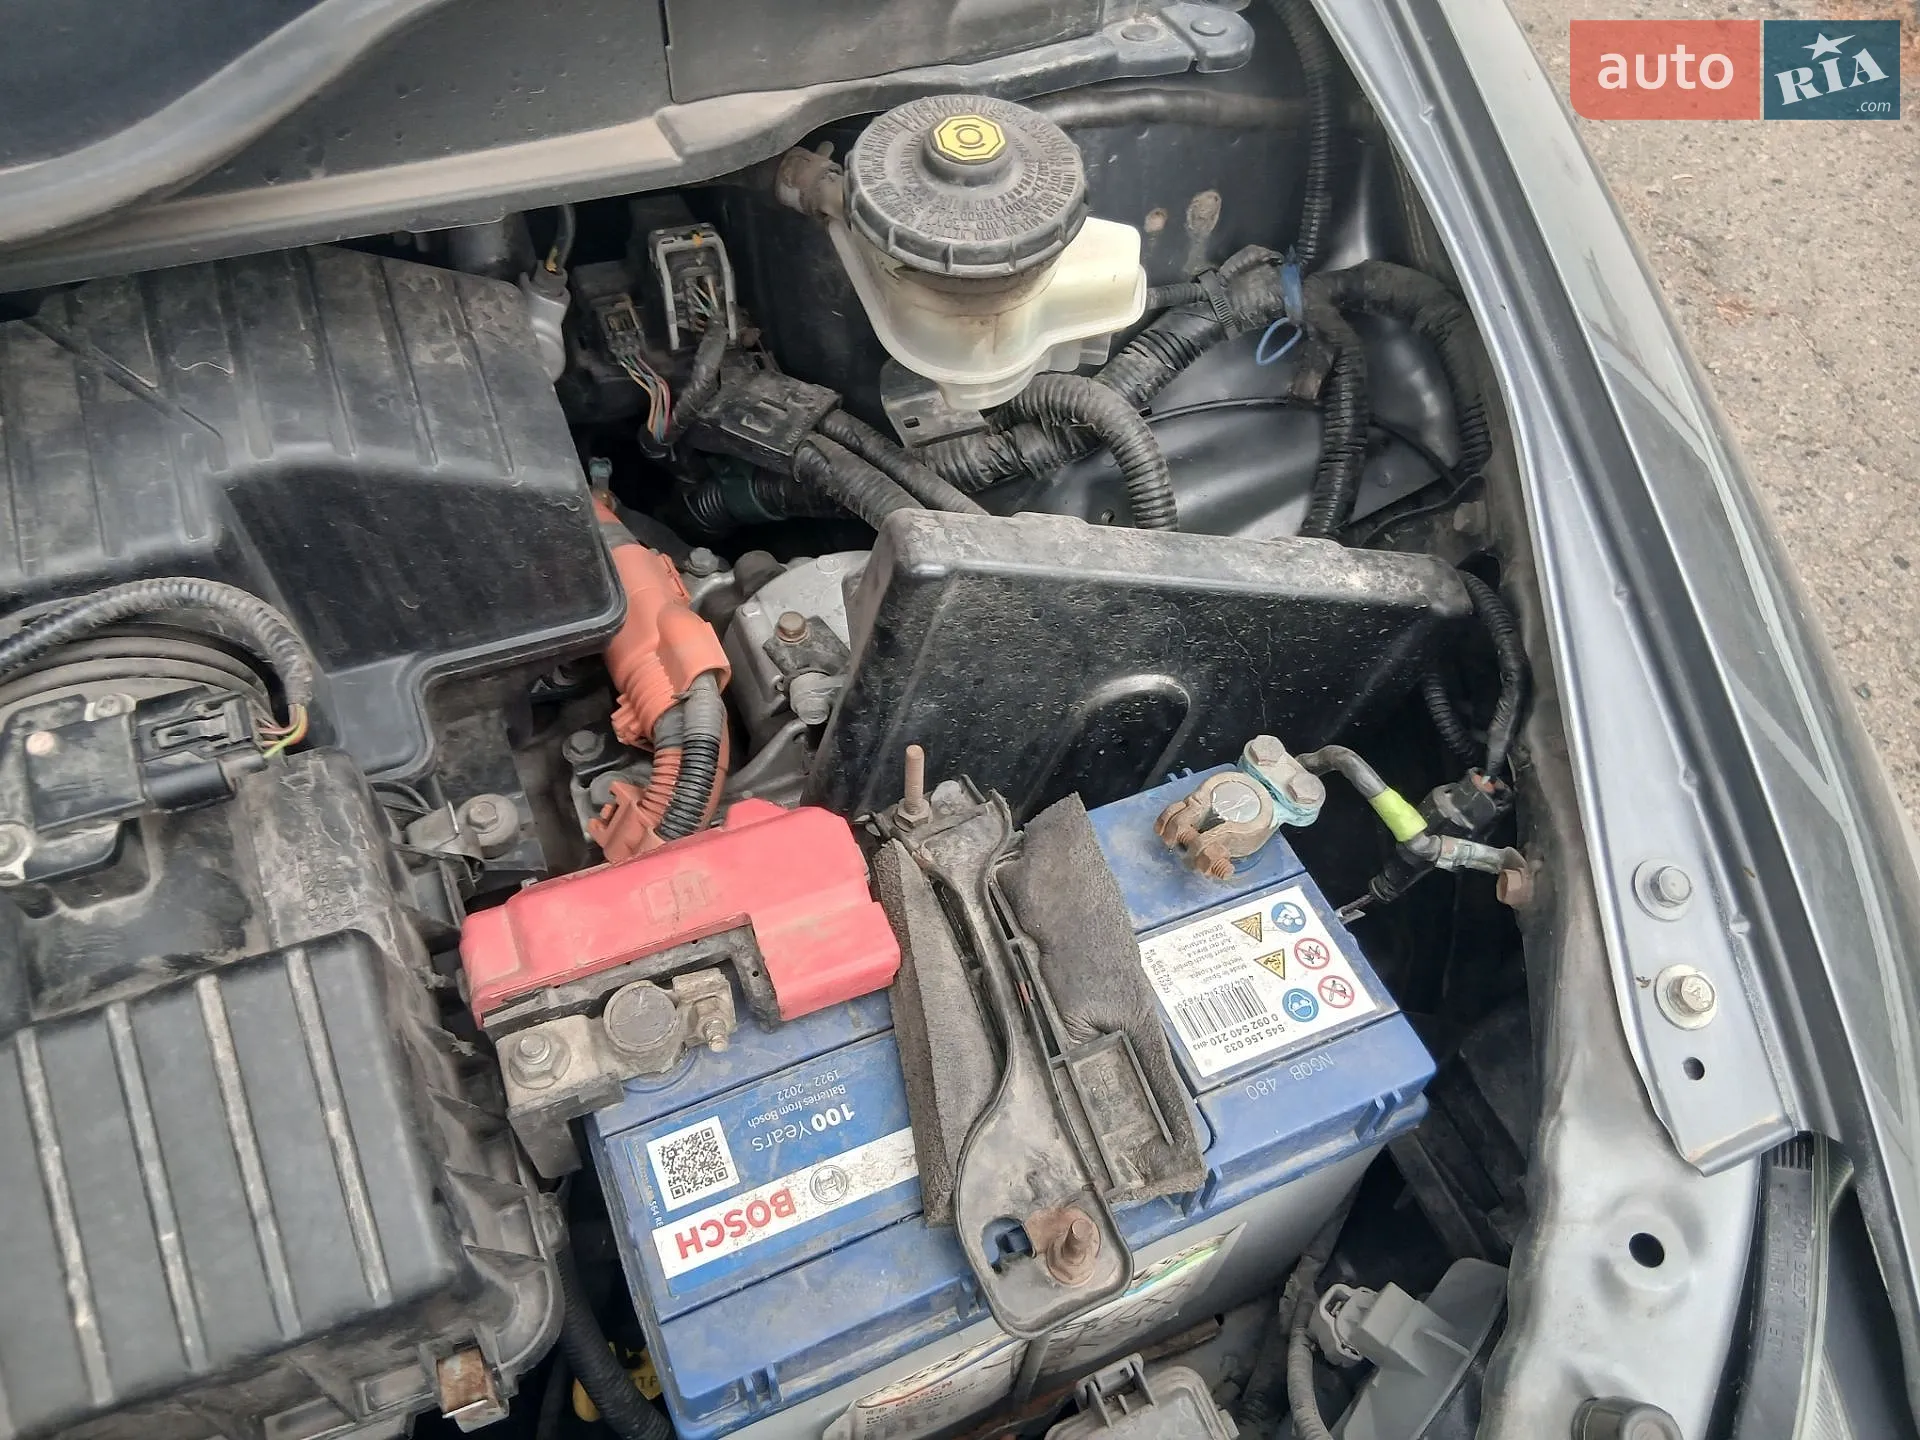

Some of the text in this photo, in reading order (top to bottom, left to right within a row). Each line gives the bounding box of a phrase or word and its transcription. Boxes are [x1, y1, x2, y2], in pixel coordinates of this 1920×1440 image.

[1249, 1016, 1270, 1030] 092
[1270, 1012, 1278, 1022] 0
[1208, 1032, 1228, 1047] 210
[1223, 1023, 1284, 1053] 545 156 033
[1228, 1024, 1249, 1038] S40
[812, 1068, 840, 1087] 1922
[775, 1082, 803, 1101] 2022
[1244, 1075, 1279, 1101] 480
[746, 1083, 845, 1129] Batteries from Bosch
[750, 1101, 855, 1152] 100 Years
[673, 1187, 797, 1259] BOSCH
